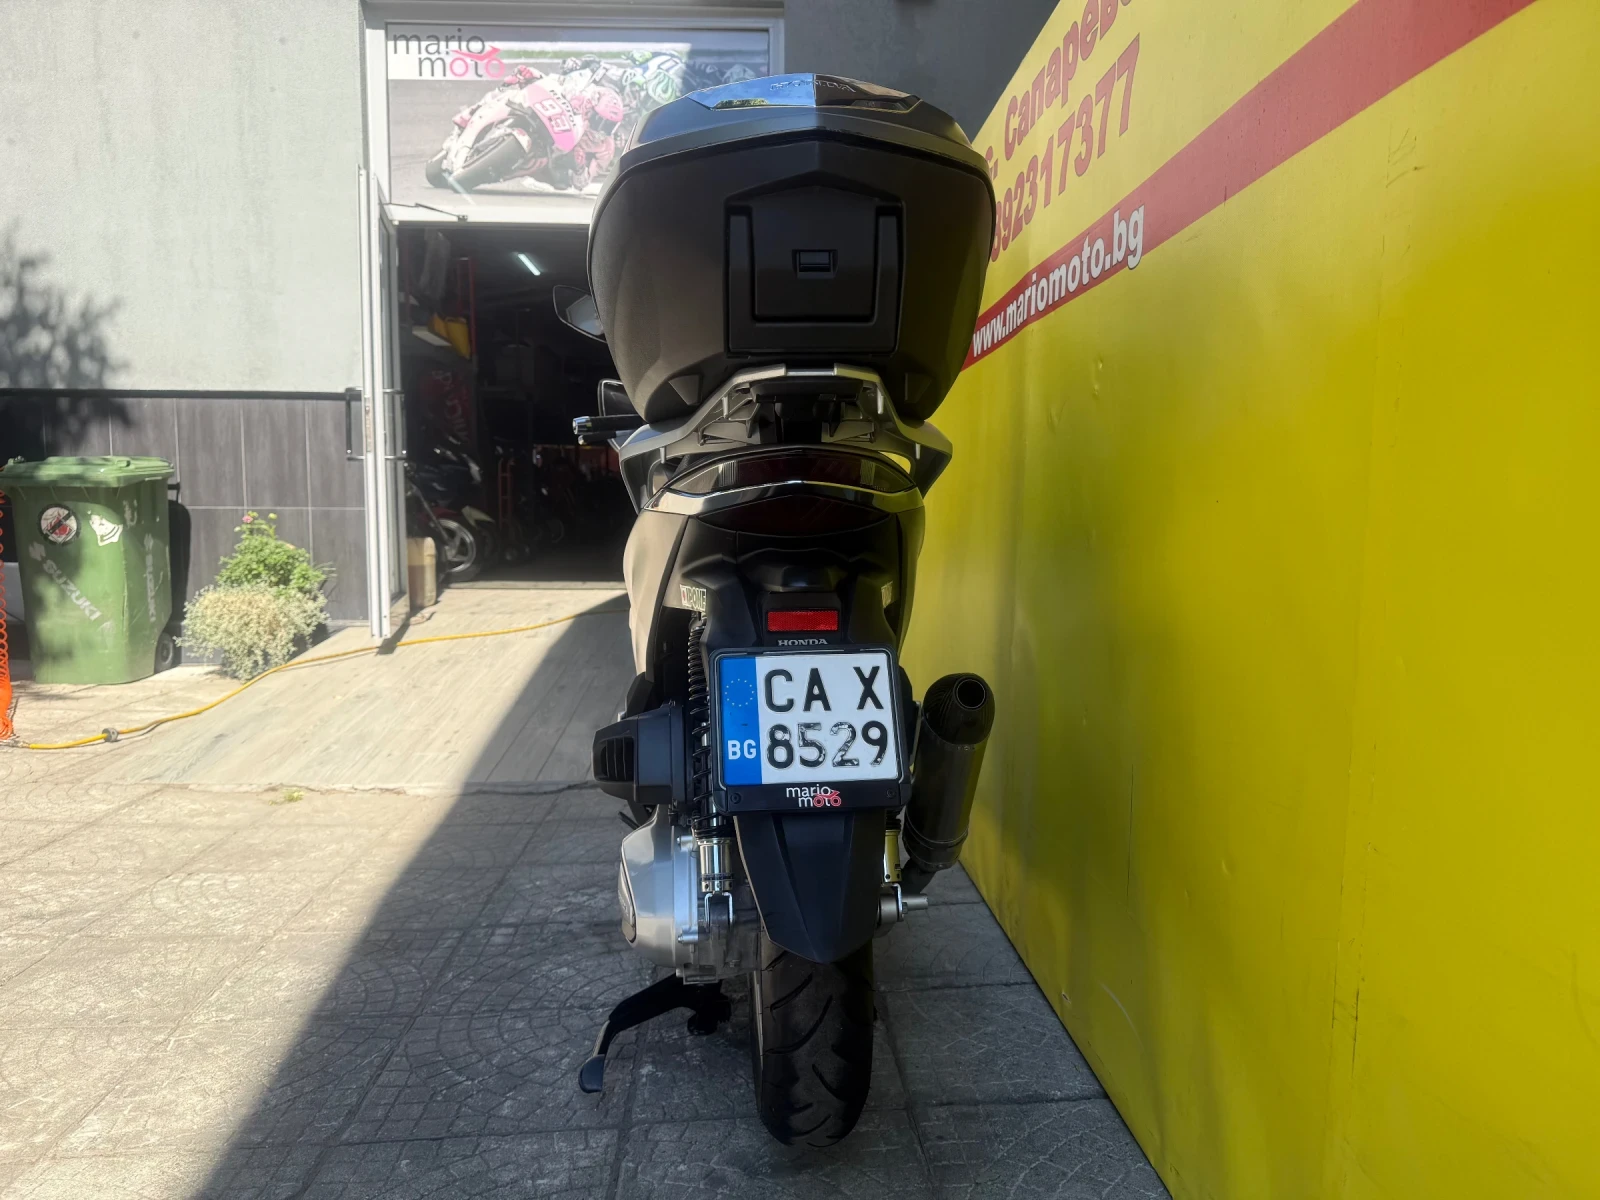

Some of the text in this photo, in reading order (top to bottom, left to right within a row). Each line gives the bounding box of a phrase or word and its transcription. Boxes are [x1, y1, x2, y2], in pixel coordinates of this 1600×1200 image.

[392, 27, 486, 55] mario
[418, 57, 505, 78] moto
[1004, 0, 1131, 162] Сапарев
[533, 98, 572, 134] 93
[972, 203, 1146, 358] www.mariomoto.bg
[42, 557, 102, 622] SUZUKI
[777, 638, 829, 646] HONDA
[764, 665, 884, 713] CA X
[727, 739, 757, 760] BG
[766, 720, 889, 769] 8529
[785, 783, 832, 798] mario
[798, 795, 842, 807] moto
